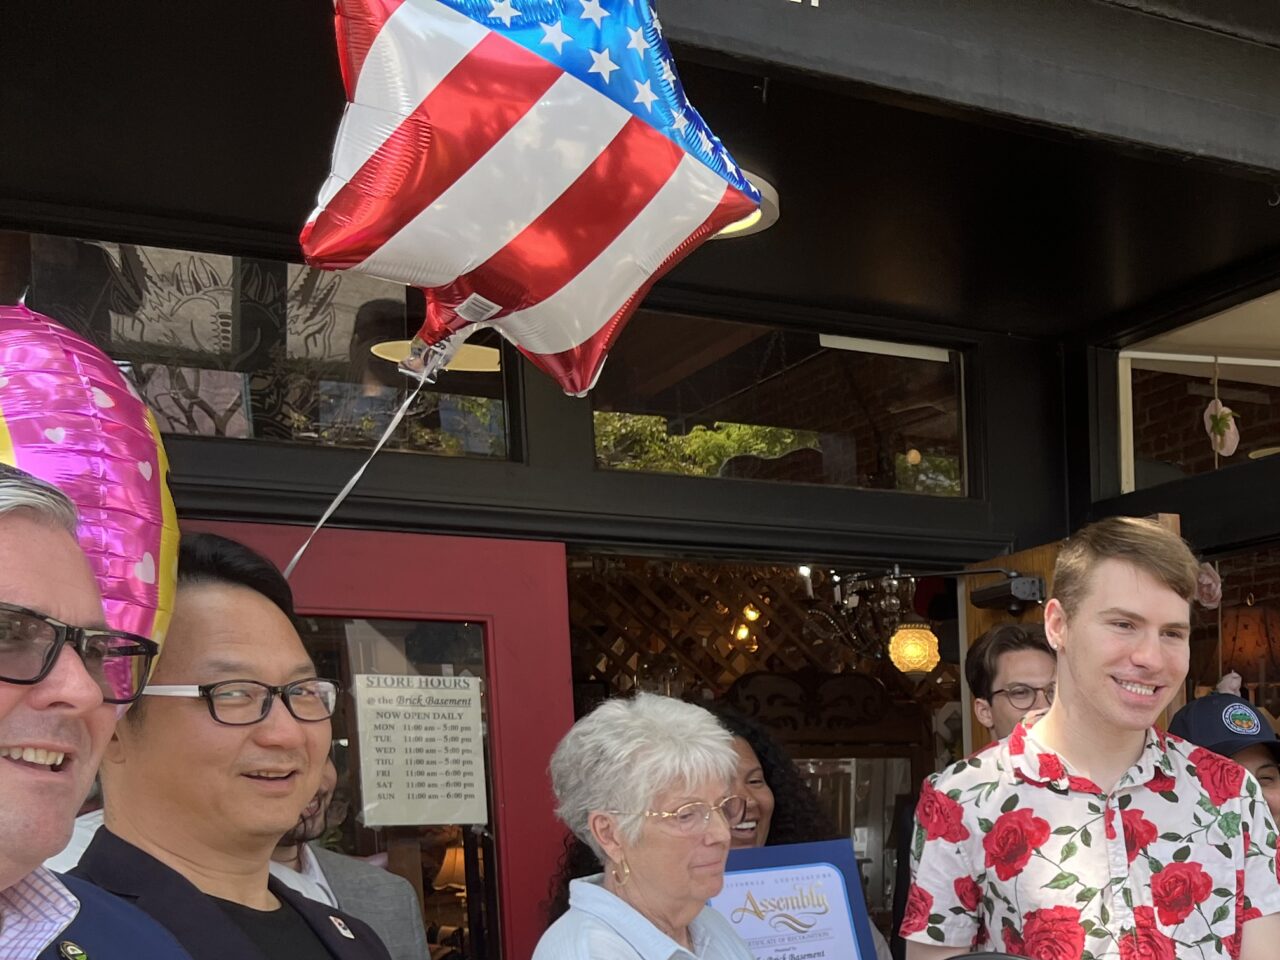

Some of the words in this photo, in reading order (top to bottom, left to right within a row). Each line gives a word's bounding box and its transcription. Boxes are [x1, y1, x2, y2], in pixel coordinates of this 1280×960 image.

[366, 676, 414, 688] STORE
[418, 677, 470, 689] HOURS
[378, 696, 394, 704] the
[396, 695, 426, 706] Brick
[426, 696, 472, 706] Basement
[376, 712, 401, 720] NOW
[403, 712, 430, 720] OPEN
[432, 712, 464, 720] DAILY
[731, 882, 829, 924] Assembly
